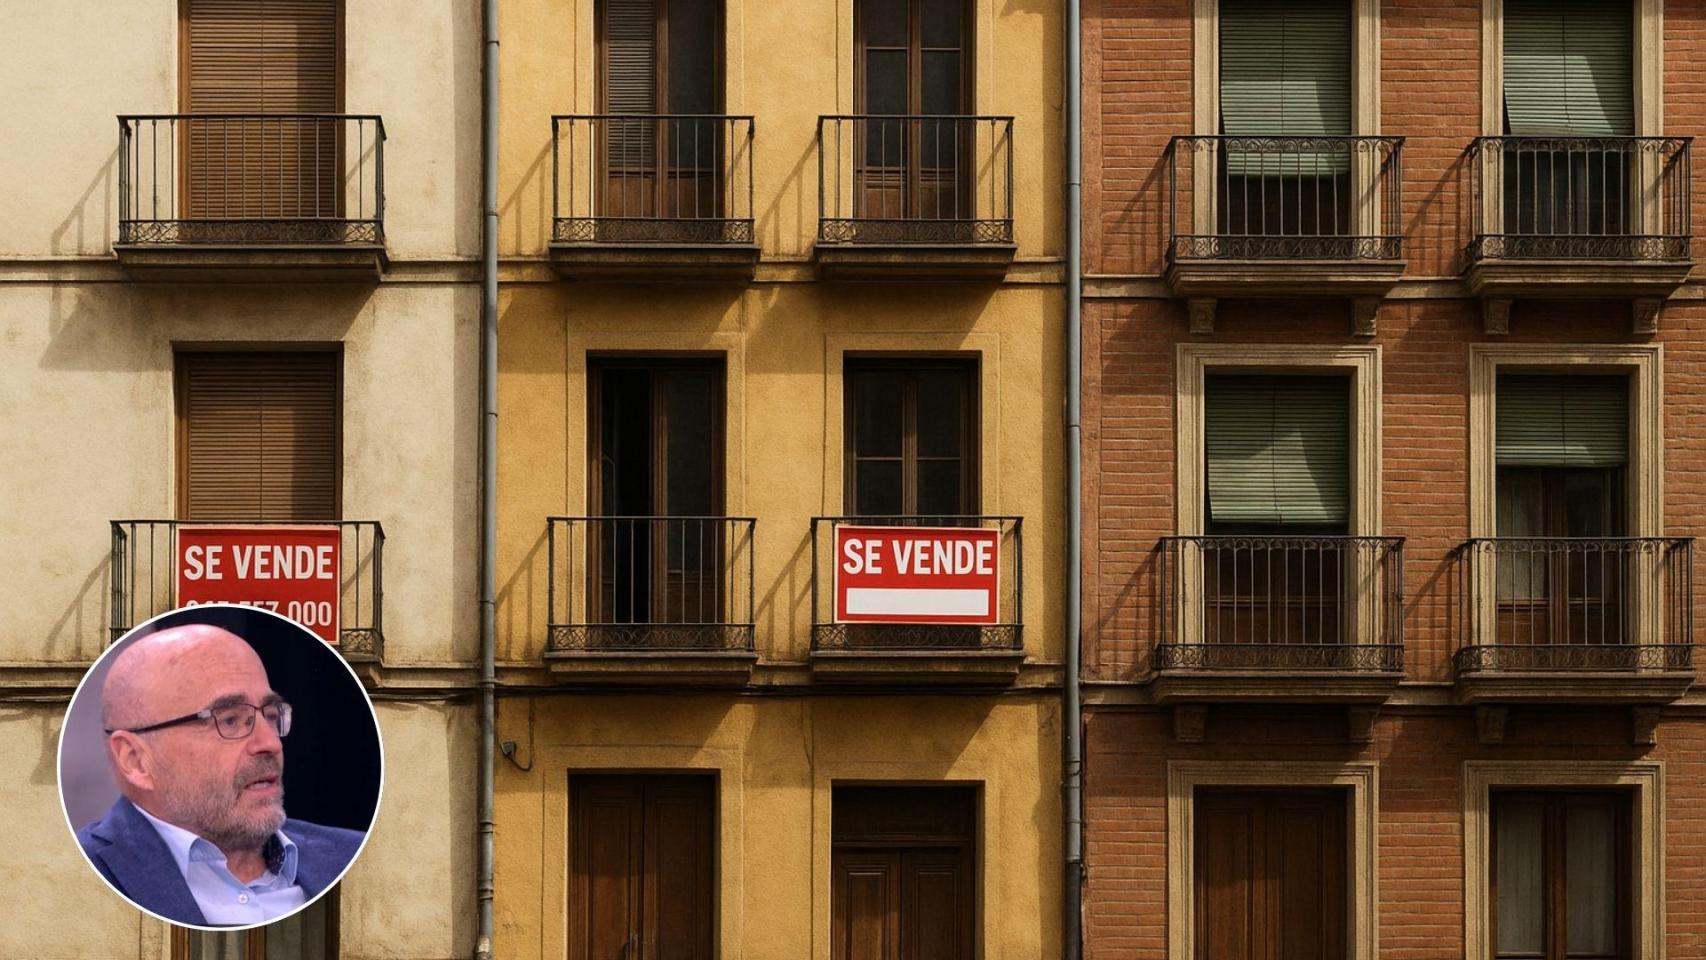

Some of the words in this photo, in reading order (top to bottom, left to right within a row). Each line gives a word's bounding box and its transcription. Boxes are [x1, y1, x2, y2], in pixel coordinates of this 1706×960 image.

[184, 545, 223, 580] SE
[232, 545, 333, 580] VENDE
[843, 538, 883, 575] SE
[892, 539, 993, 575] VENDE
